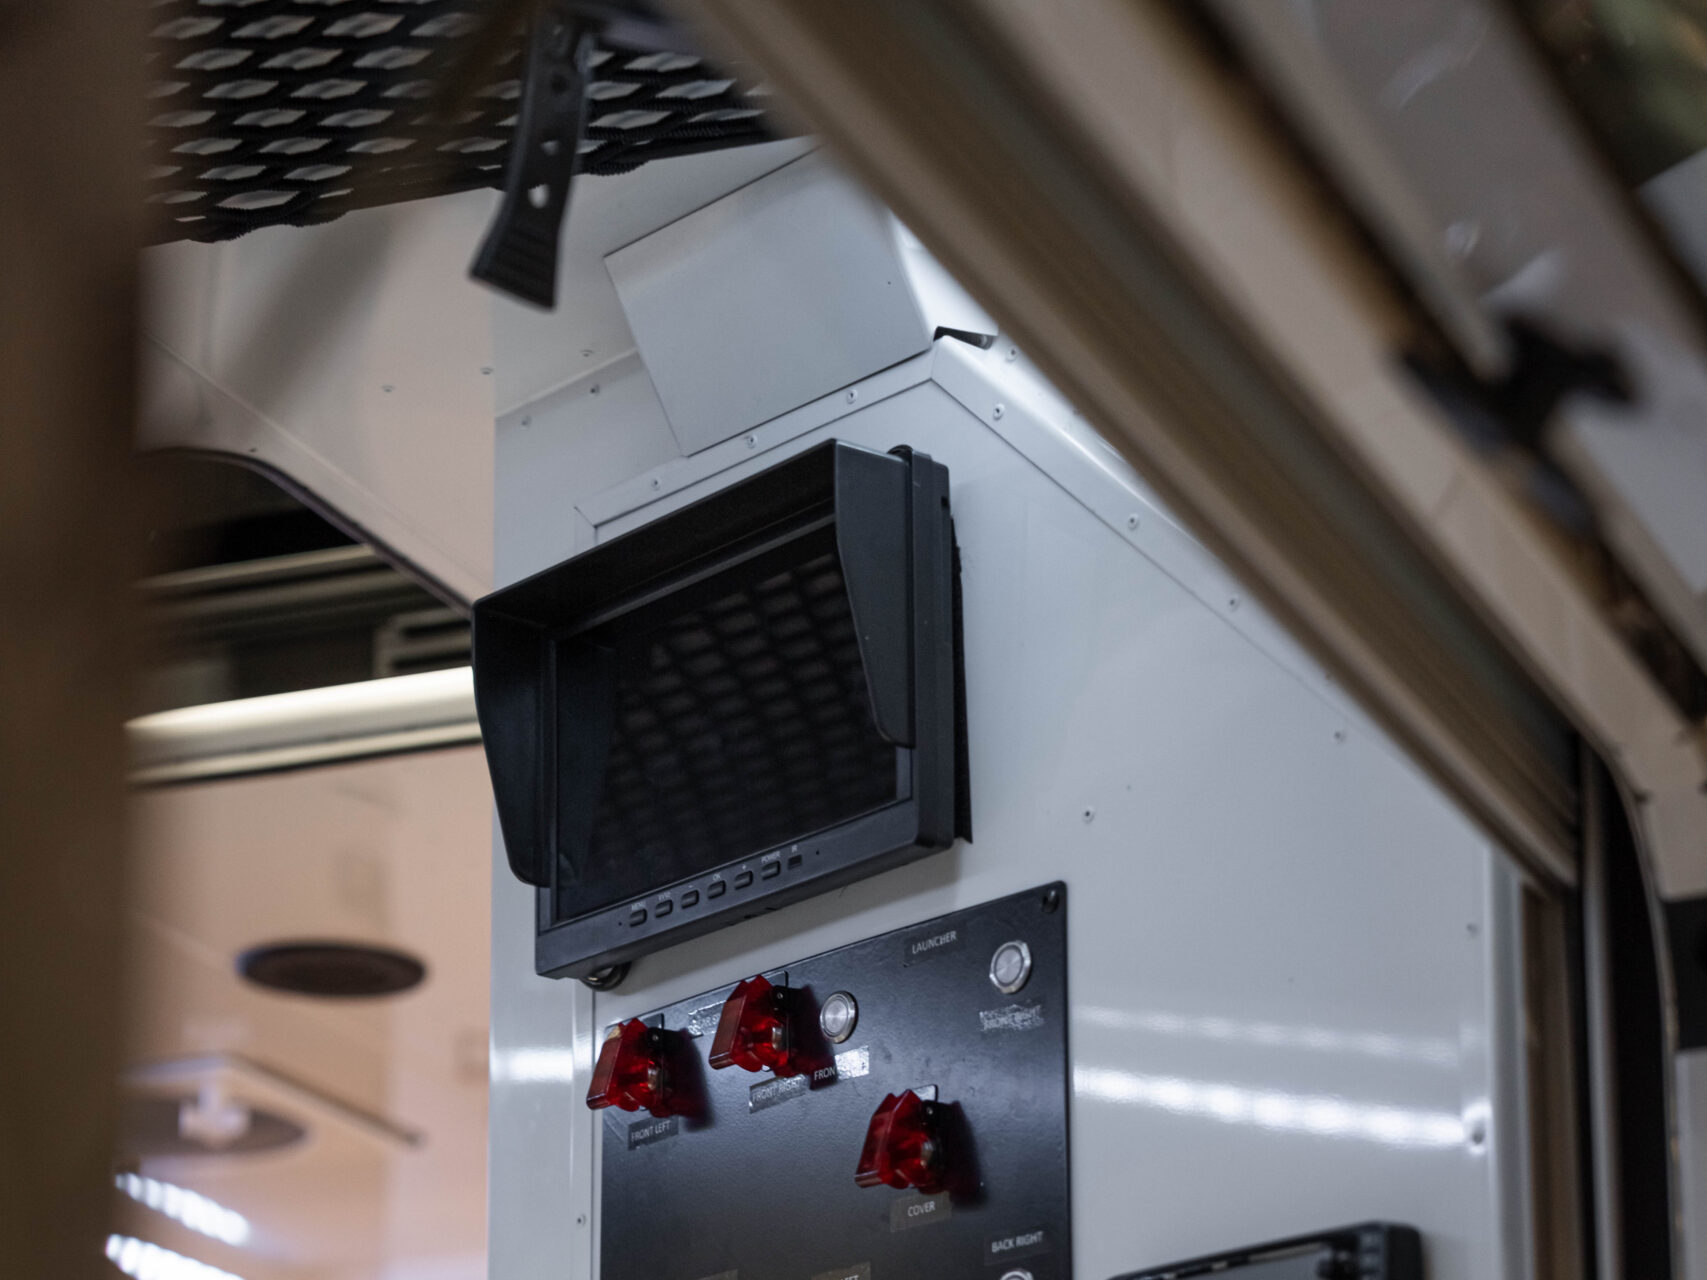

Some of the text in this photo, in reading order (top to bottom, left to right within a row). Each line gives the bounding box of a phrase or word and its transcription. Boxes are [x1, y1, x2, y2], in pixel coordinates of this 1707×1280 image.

[911, 930, 958, 955] LAUNCHER
[752, 1086, 777, 1102] FRONT
[631, 1120, 671, 1142] FRONT LEFT
[908, 1201, 935, 1217] COVER
[992, 1230, 1044, 1253] BACK RIGHT
